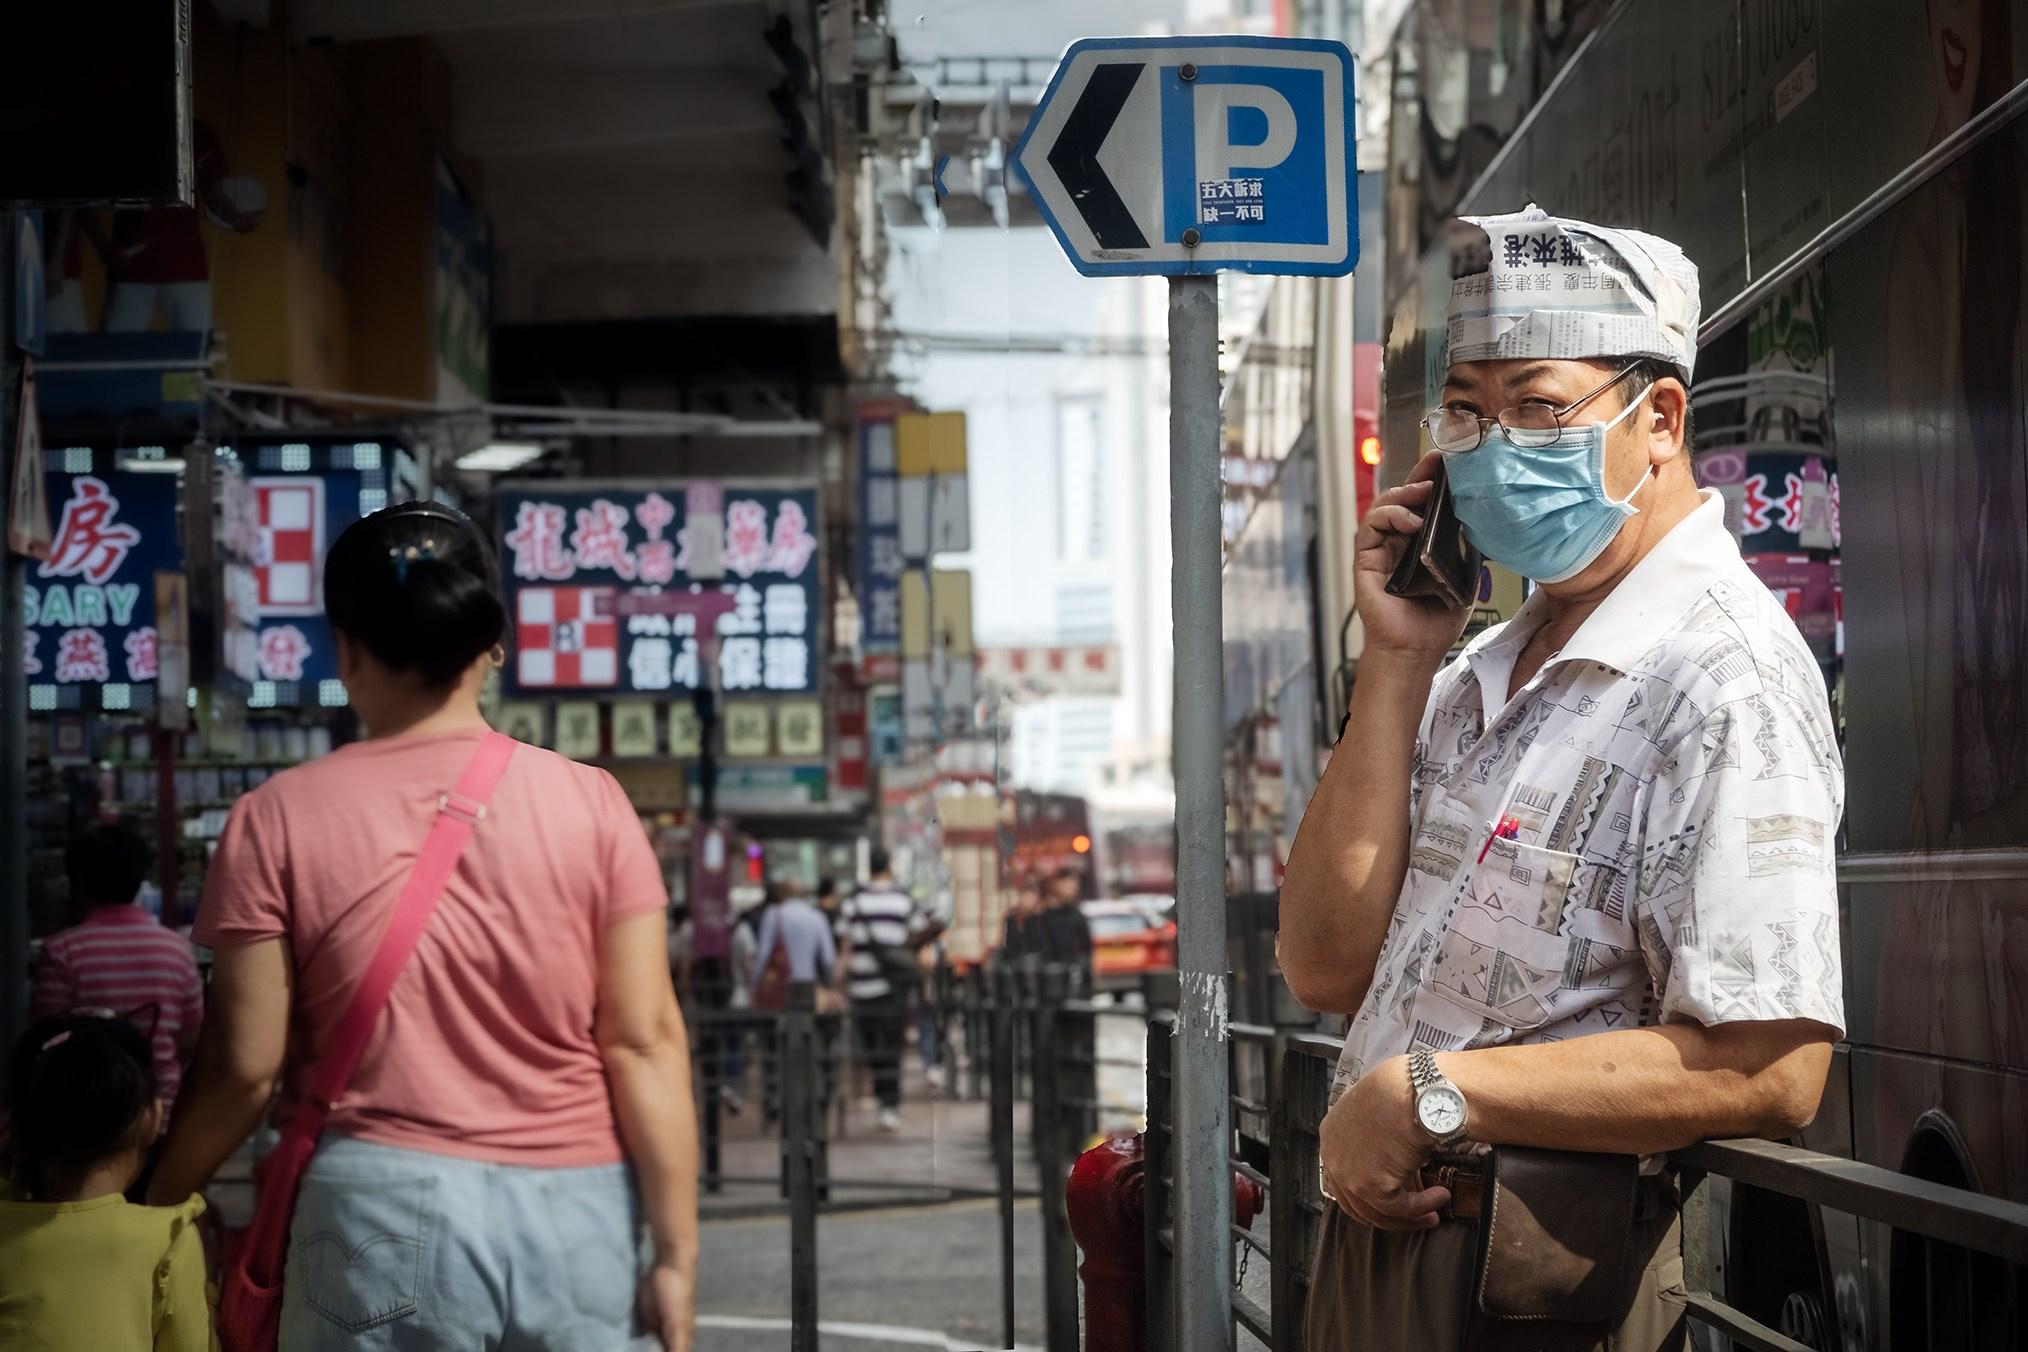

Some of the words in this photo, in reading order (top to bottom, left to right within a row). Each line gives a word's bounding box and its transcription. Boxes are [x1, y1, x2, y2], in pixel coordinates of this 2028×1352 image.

[1193, 84, 1297, 224] P
[1202, 182, 1263, 199] 五大訴求
[1203, 205, 1264, 222] 缺一不可
[1503, 233, 1599, 268] 雄來港
[38, 476, 141, 584] 房
[505, 493, 817, 584] 龍城中西藥房
